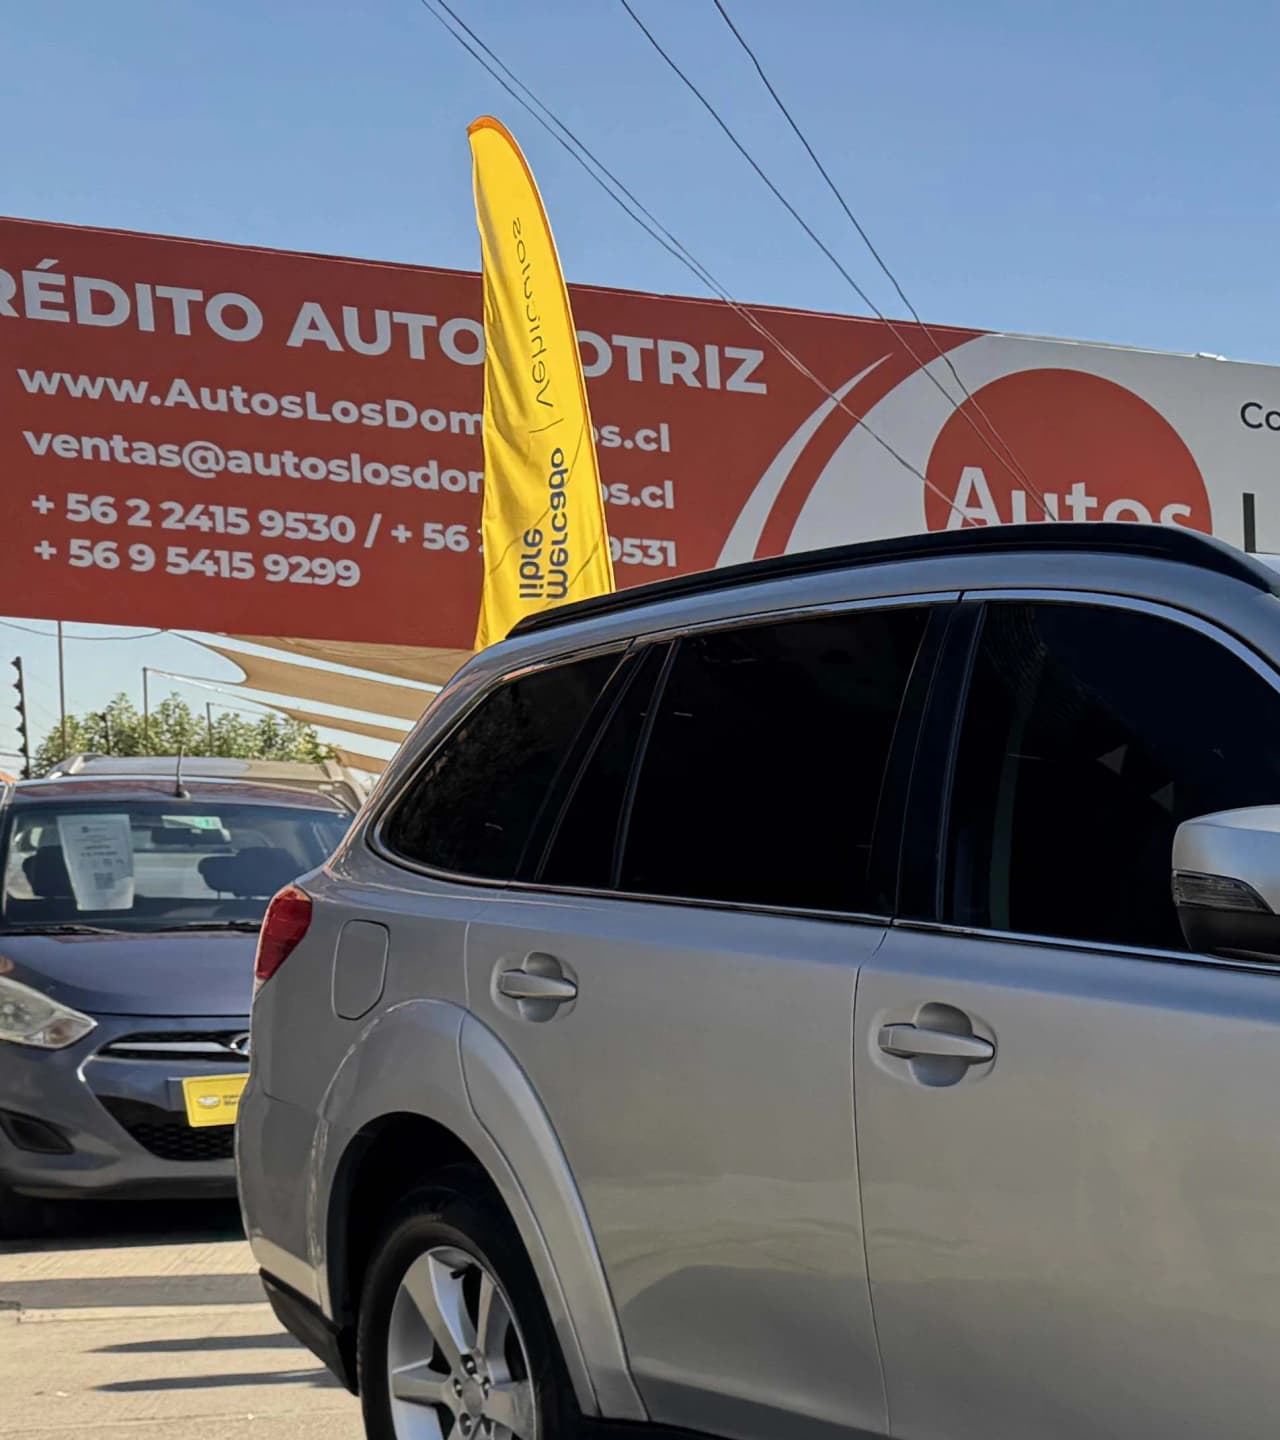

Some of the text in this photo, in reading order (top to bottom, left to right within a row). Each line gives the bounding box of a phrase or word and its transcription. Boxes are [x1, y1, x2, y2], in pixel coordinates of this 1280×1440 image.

[286, 302, 767, 395] AUTOOTRIZ
[65, 493, 118, 524] 56
[125, 498, 152, 527] 2
[160, 501, 250, 535] 2415
[258, 509, 356, 543] 9530
[422, 522, 470, 552] 56
[68, 538, 120, 569] 56
[128, 543, 156, 572] 9
[165, 546, 256, 580] 5415
[262, 553, 361, 587] 9299
